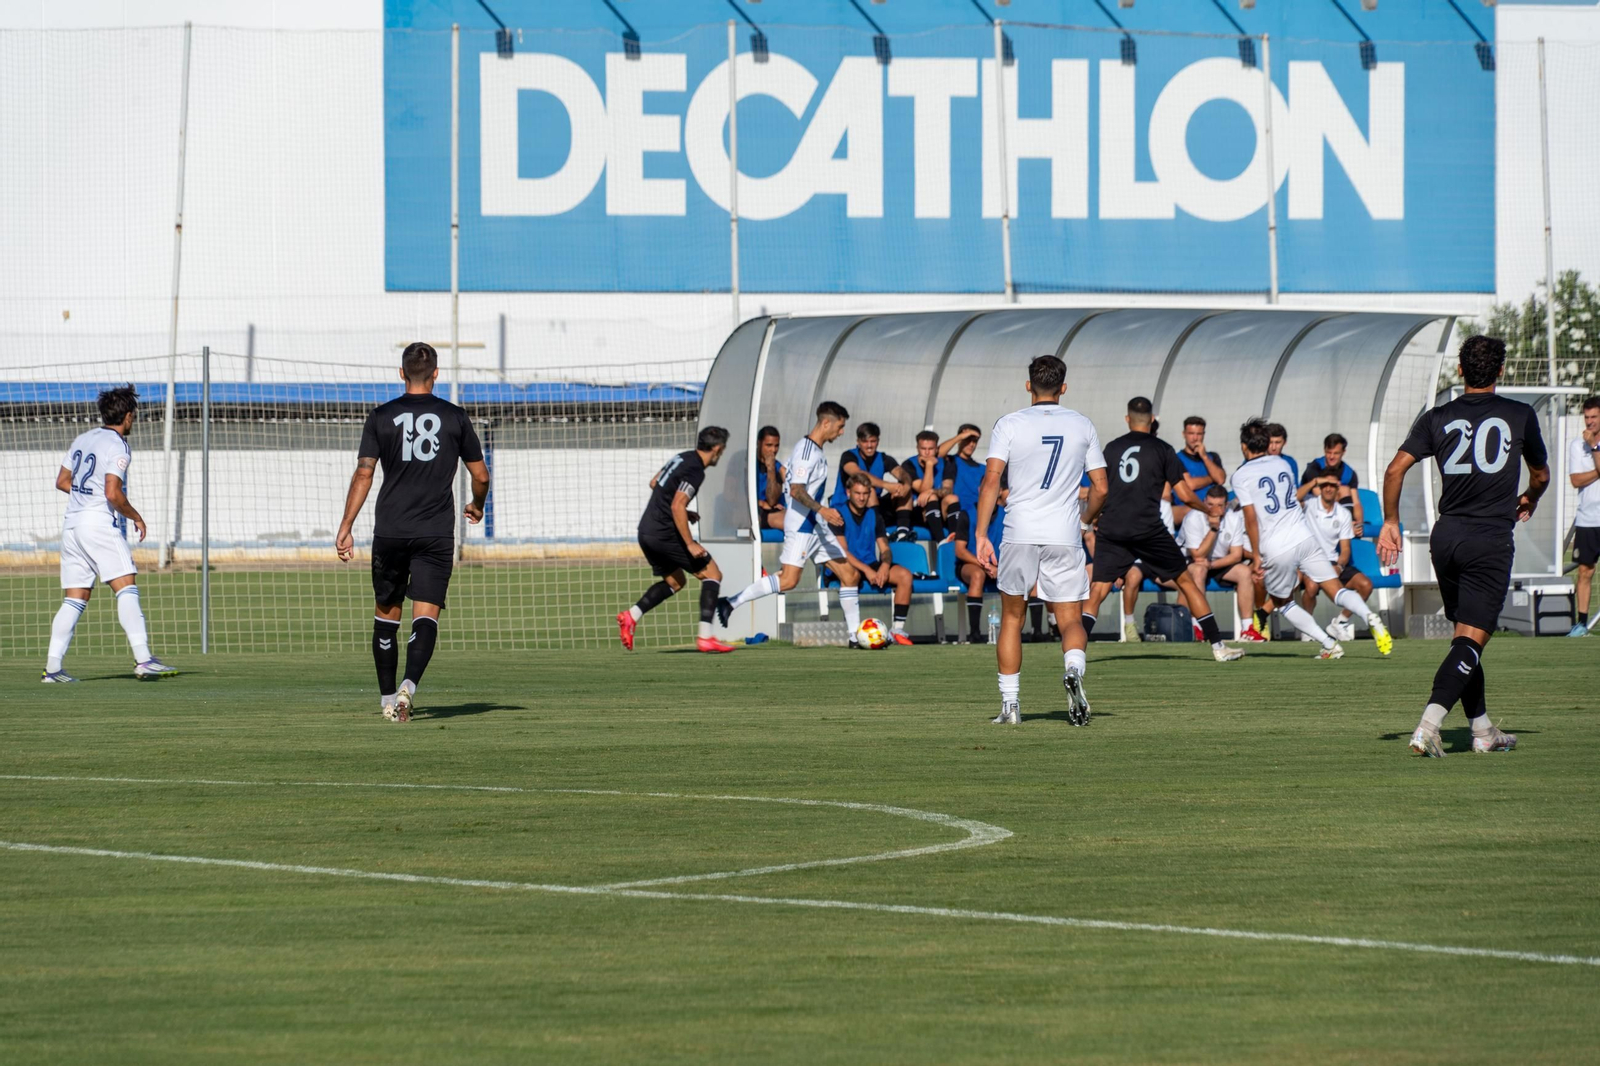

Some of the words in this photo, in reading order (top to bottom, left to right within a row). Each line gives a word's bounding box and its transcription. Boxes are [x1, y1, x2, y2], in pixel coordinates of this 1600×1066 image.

[479, 52, 1405, 221] DECATHLON
[393, 412, 441, 461] 18
[1443, 417, 1512, 474] 20
[71, 450, 97, 495] 22
[1040, 435, 1064, 490] 7
[1119, 445, 1141, 483] 6
[1258, 472, 1297, 514] 32
